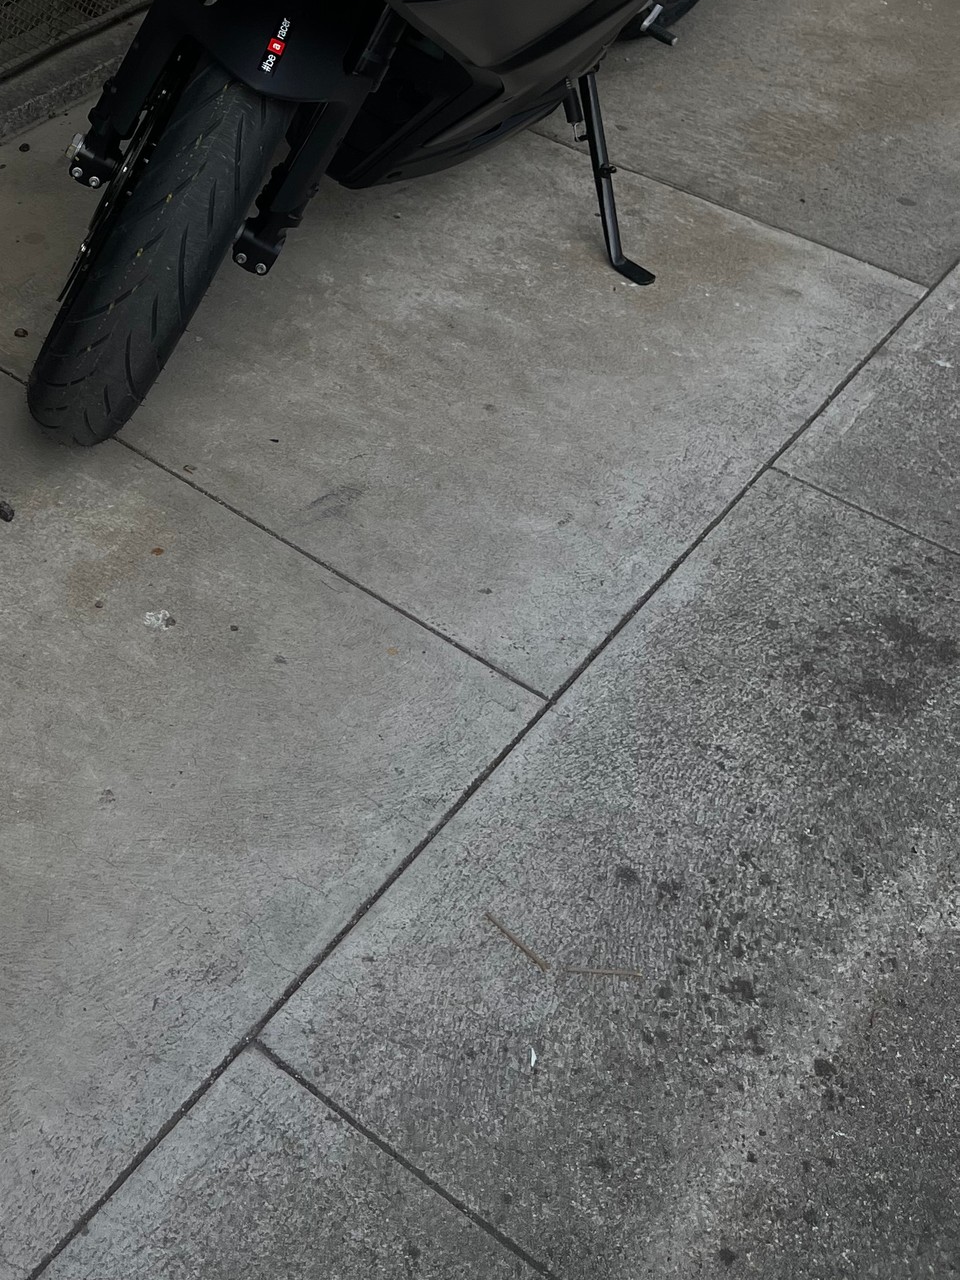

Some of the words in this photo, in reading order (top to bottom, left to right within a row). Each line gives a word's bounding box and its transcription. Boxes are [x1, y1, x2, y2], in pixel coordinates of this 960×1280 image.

[261, 54, 276, 73] #be
[272, 42, 281, 51] a
[277, 17, 291, 40] racer
